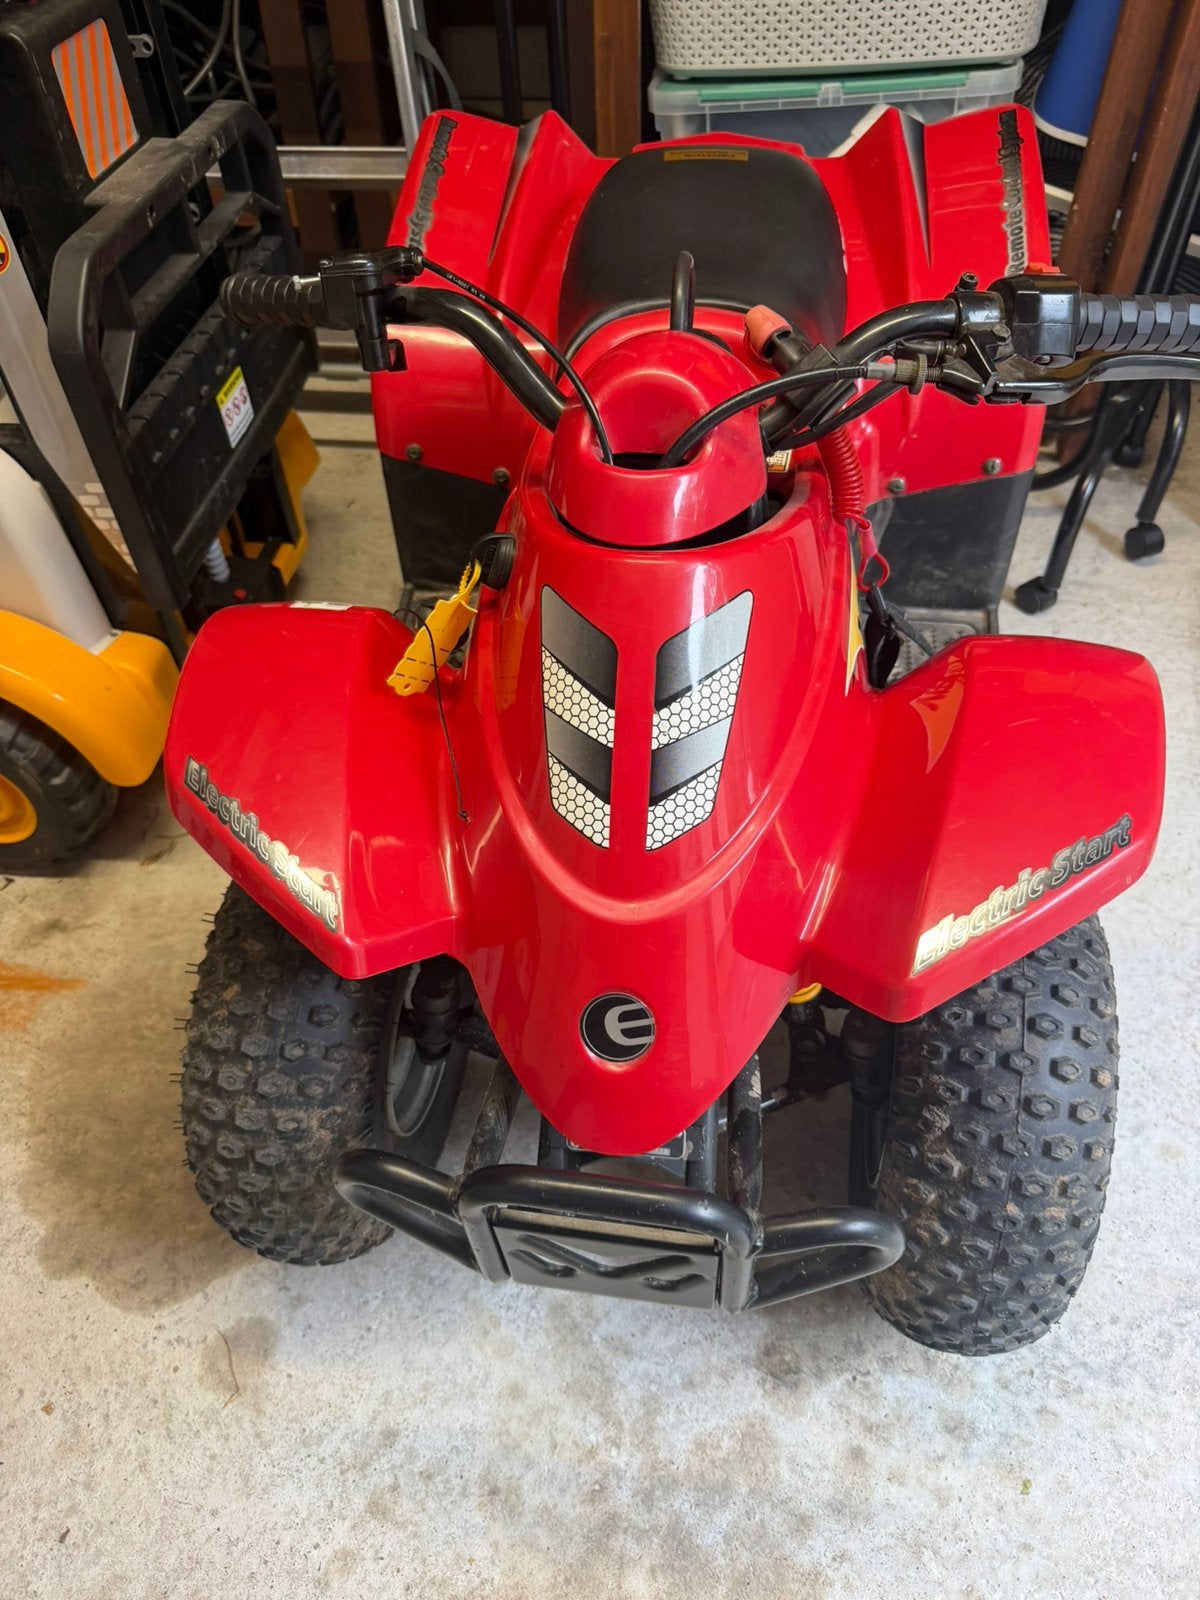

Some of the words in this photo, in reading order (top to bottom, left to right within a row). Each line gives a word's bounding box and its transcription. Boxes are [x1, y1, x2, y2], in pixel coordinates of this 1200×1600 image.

[1004, 208, 1026, 276] Remote
[185, 757, 270, 861] Electric
[271, 843, 339, 932] Start
[914, 869, 1047, 974] Electric
[1050, 815, 1132, 888] Start
